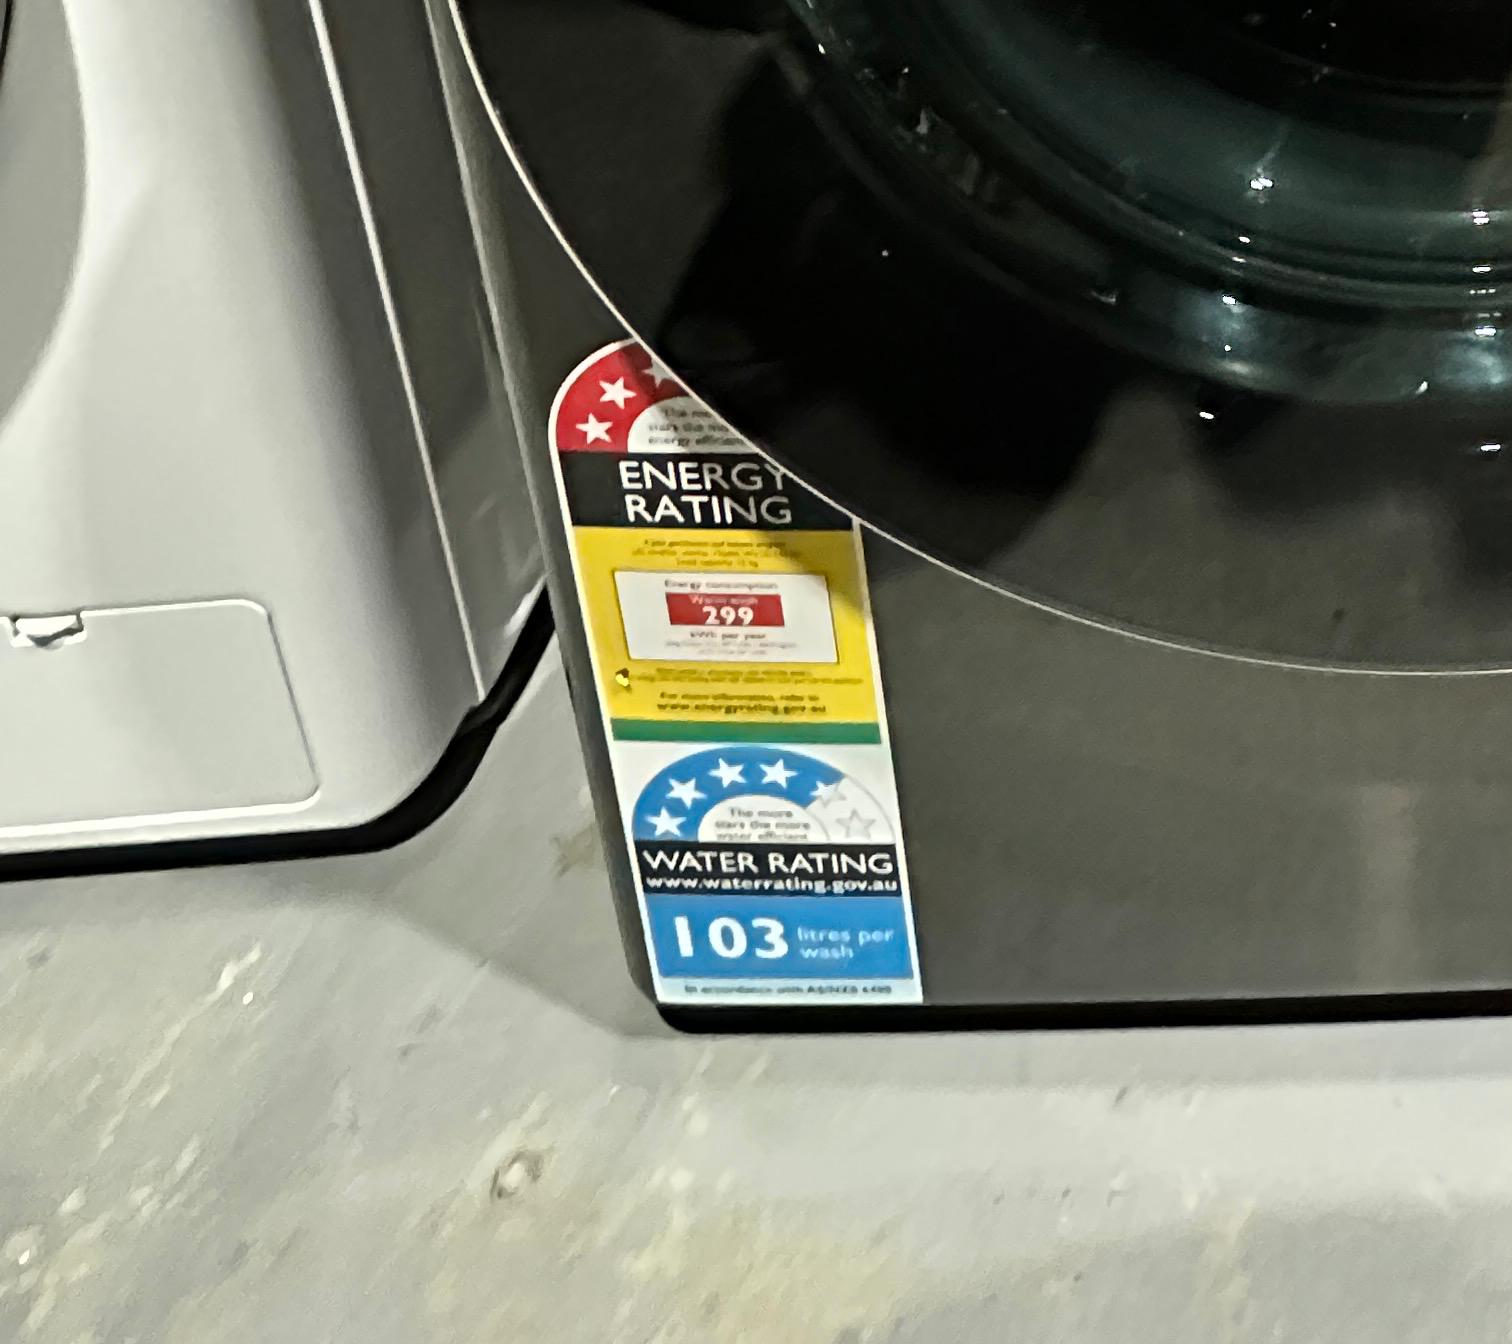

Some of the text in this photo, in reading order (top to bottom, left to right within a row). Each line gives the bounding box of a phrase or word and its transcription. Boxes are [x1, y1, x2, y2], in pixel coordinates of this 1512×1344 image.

[618, 460, 786, 491] ENERGY
[624, 494, 792, 525] RATING
[702, 605, 755, 626] 299
[642, 850, 895, 876] WATER RATING
[645, 875, 898, 893] www.waterrating.gov.au
[674, 914, 789, 960] 103
[796, 925, 895, 946] litres per
[799, 945, 854, 960] wash
